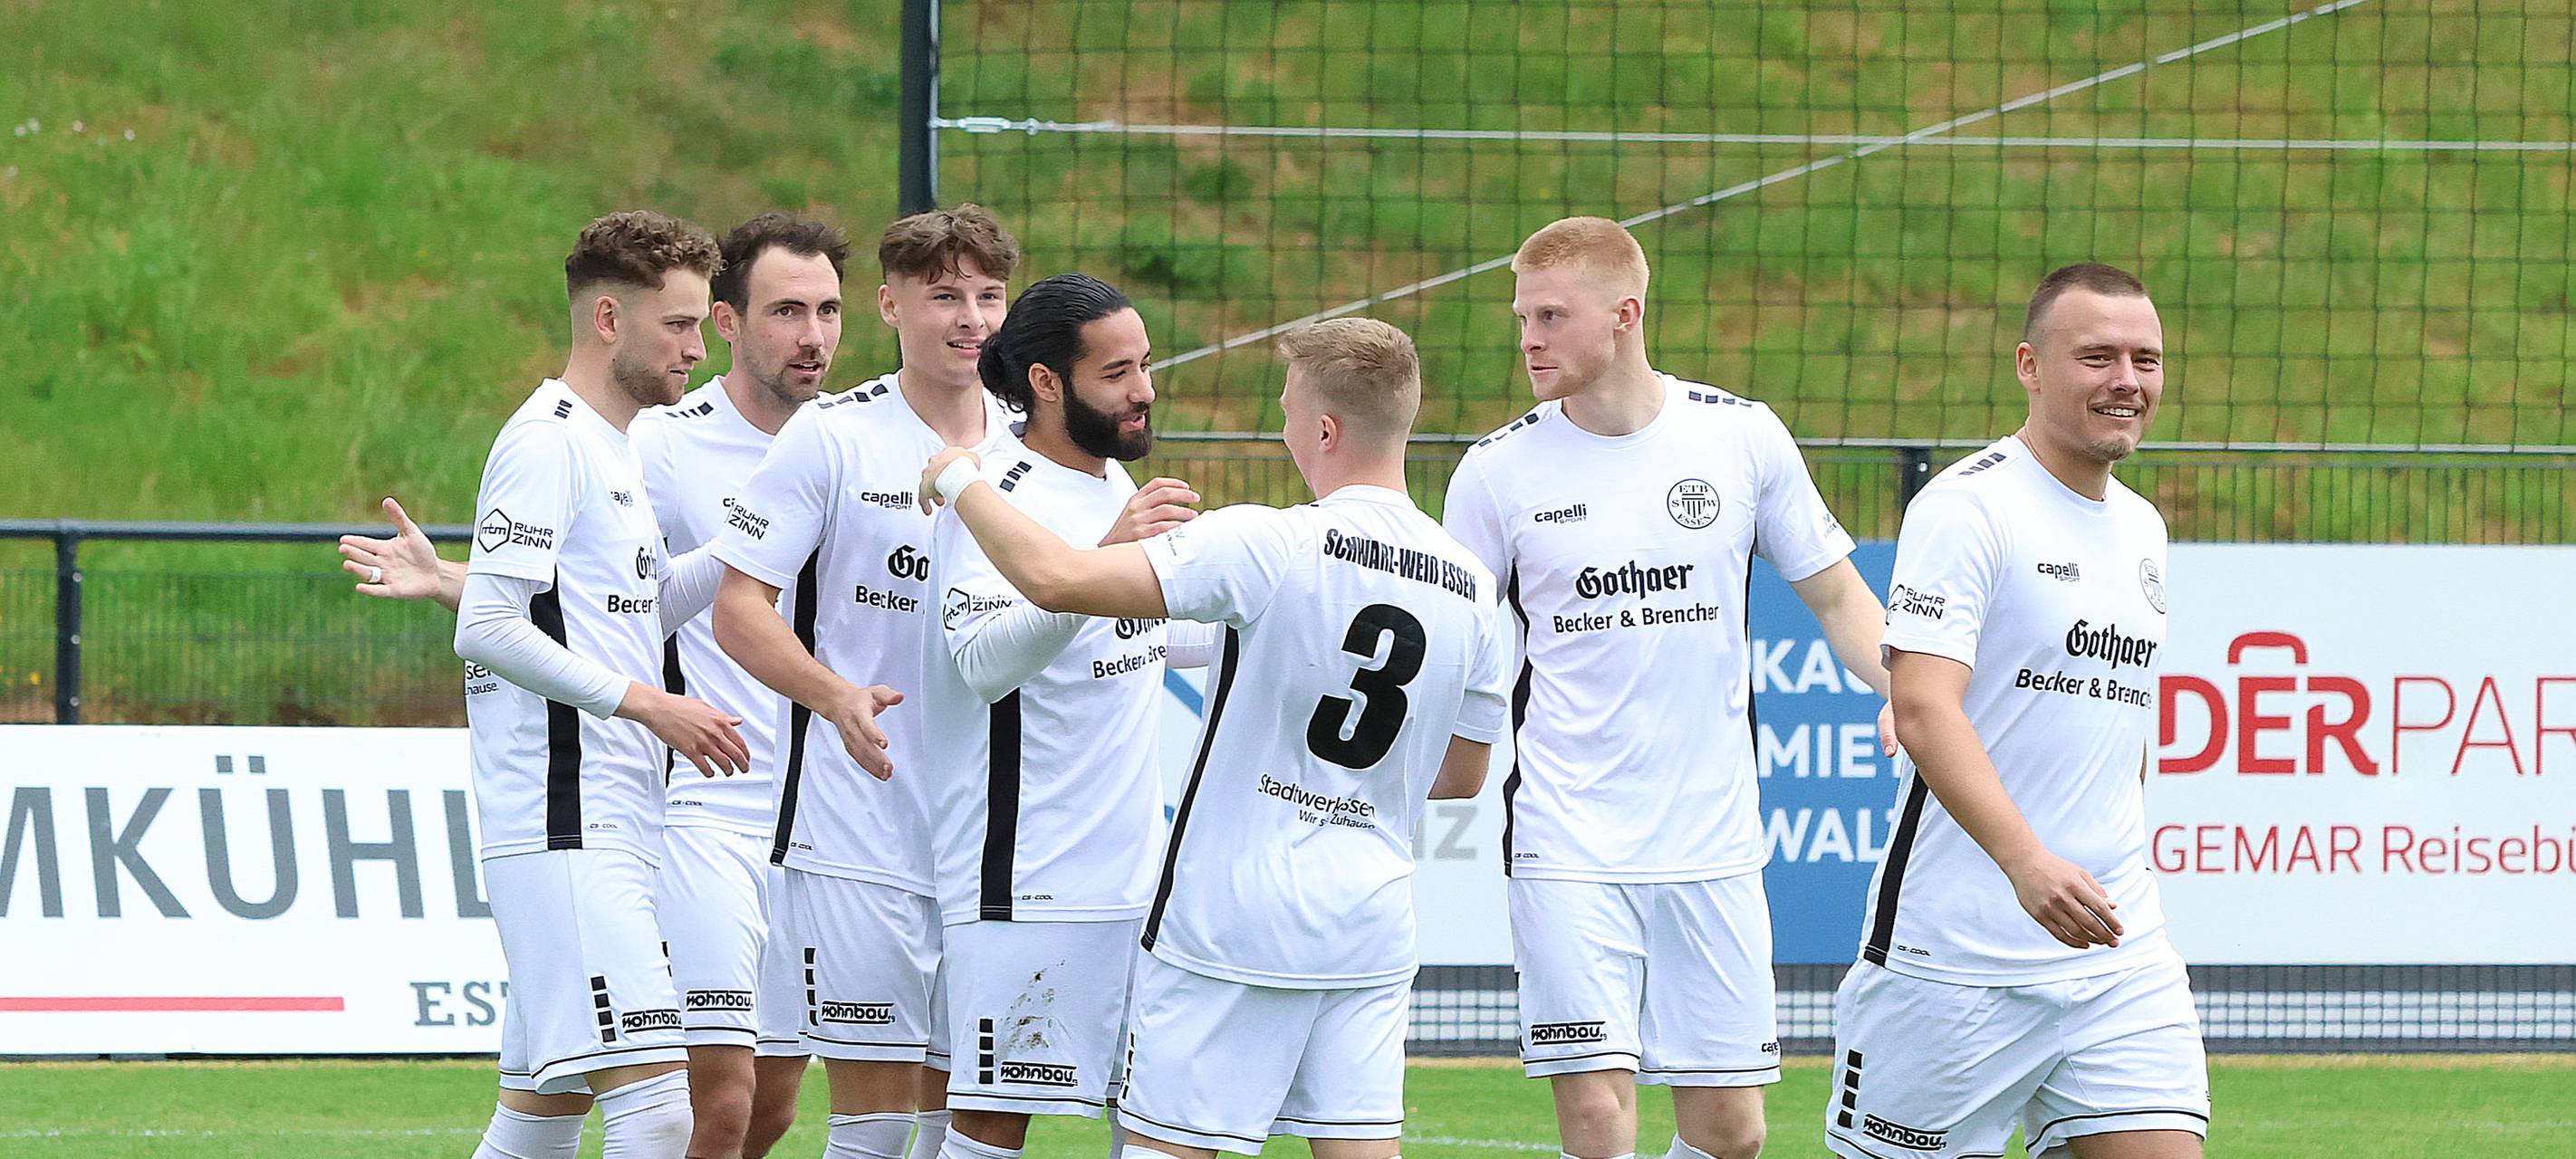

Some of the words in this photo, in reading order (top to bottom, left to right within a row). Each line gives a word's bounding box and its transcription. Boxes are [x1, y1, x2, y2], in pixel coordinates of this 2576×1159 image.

[860, 491, 913, 506] capelli
[734, 504, 770, 530] RUHR
[1534, 503, 1587, 523] capelli
[514, 522, 553, 538] RUHR
[728, 513, 765, 541] ZINN
[511, 532, 553, 550] ZINN
[1441, 560, 1476, 603] ESSEN
[1575, 560, 1694, 599] Gothaer
[2037, 561, 2080, 579] capelli
[855, 585, 918, 613] Becker
[972, 599, 1013, 612] ZINN
[1902, 598, 1943, 620] ZINN
[1906, 588, 1946, 607] RUHR
[1553, 612, 1613, 634] Becker
[1620, 610, 1637, 627] &
[1642, 602, 1719, 626] Brencher
[2066, 618, 2158, 670] Gothaer
[1092, 654, 1142, 679] Becker
[1305, 603, 1427, 770] 3
[2015, 668, 2083, 695] Becker
[2089, 677, 2101, 698] &
[2107, 679, 2152, 710] Brenc
[1299, 809, 1318, 825] Wir
[1766, 809, 1895, 862] WAL
[2152, 824, 2362, 875] GEMAR
[409, 982, 509, 1027] ES
